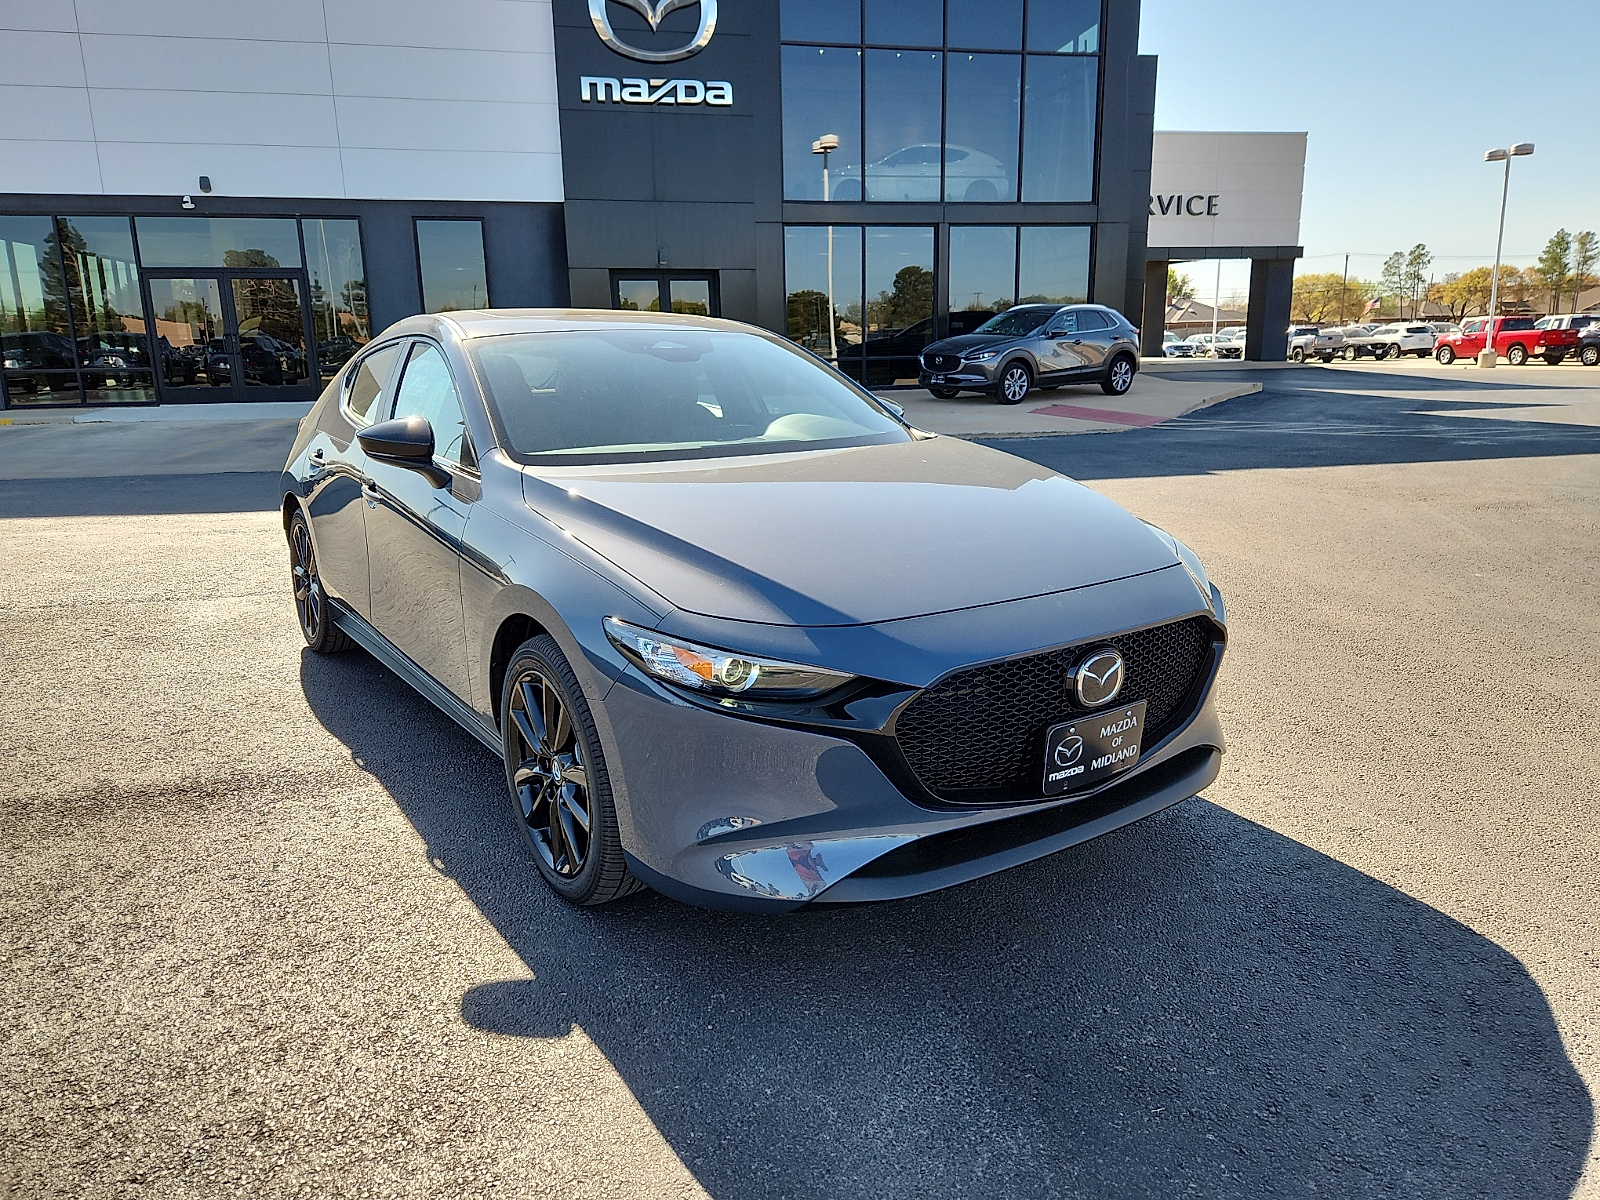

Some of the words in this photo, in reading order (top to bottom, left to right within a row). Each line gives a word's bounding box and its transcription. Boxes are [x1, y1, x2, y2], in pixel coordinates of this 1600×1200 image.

[580, 76, 733, 105] mazda
[1100, 716, 1137, 738] MAZDA
[1112, 736, 1123, 747] OF
[1090, 745, 1137, 770] MIDLAND
[1048, 765, 1085, 782] mazda
